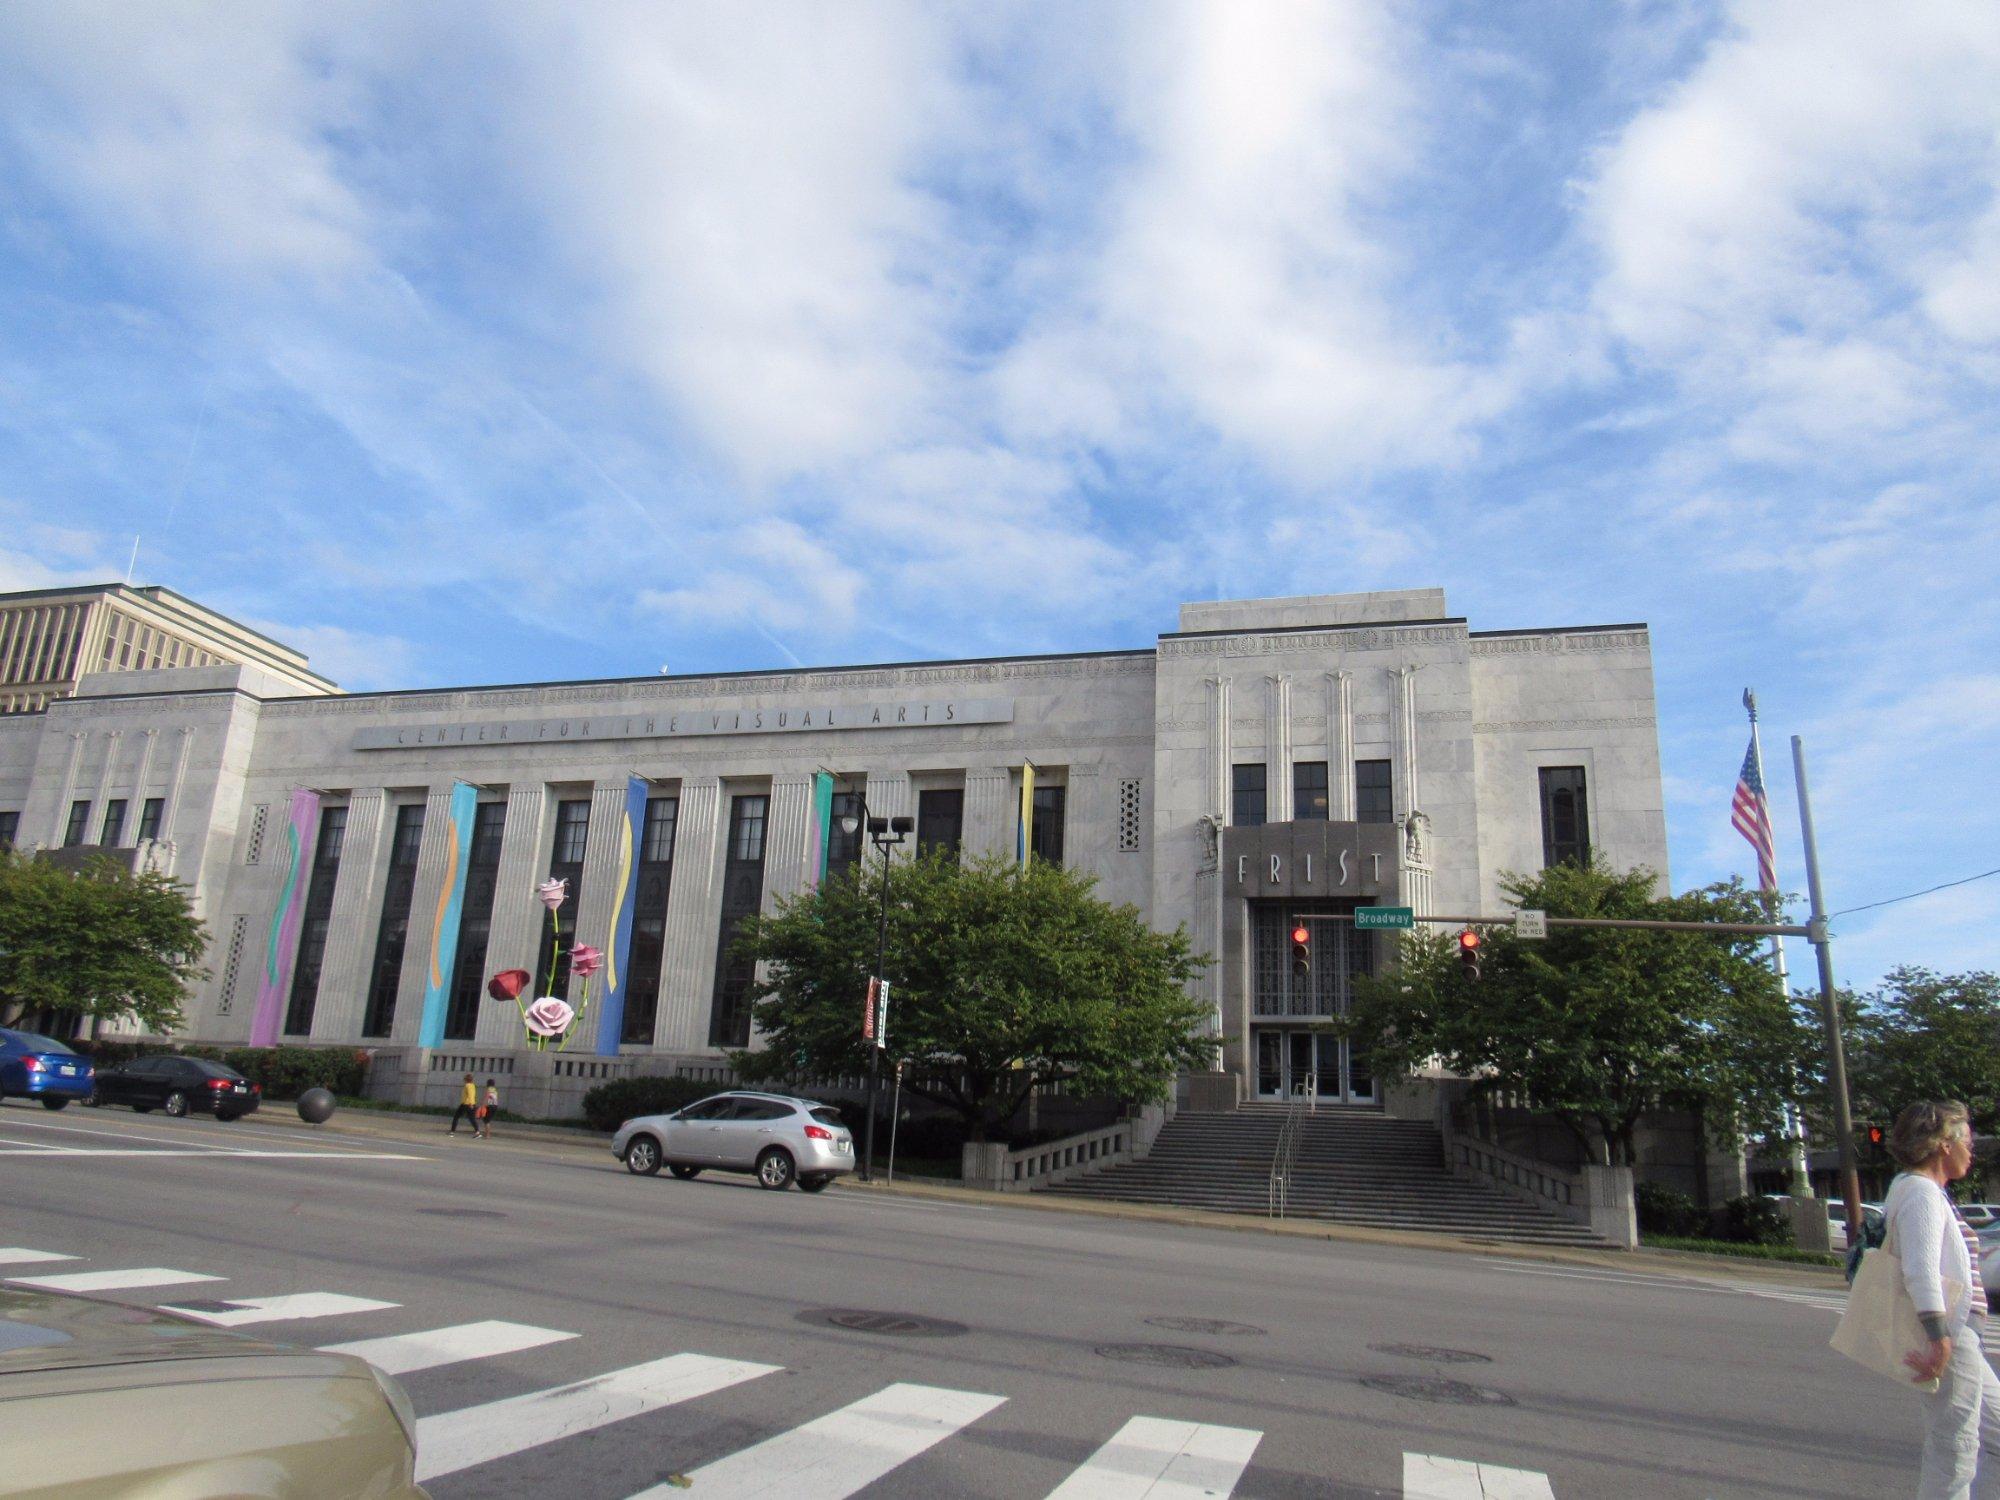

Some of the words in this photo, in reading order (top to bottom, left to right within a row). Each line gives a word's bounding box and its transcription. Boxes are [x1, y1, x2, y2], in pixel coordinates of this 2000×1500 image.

[398, 725, 508, 744] CENTER
[539, 720, 590, 738] FOR
[625, 716, 677, 735] THE
[712, 709, 835, 730] VISUAL
[871, 704, 954, 724] ARTS
[1238, 849, 1382, 886] FRIST
[1358, 912, 1410, 925] Broadway
